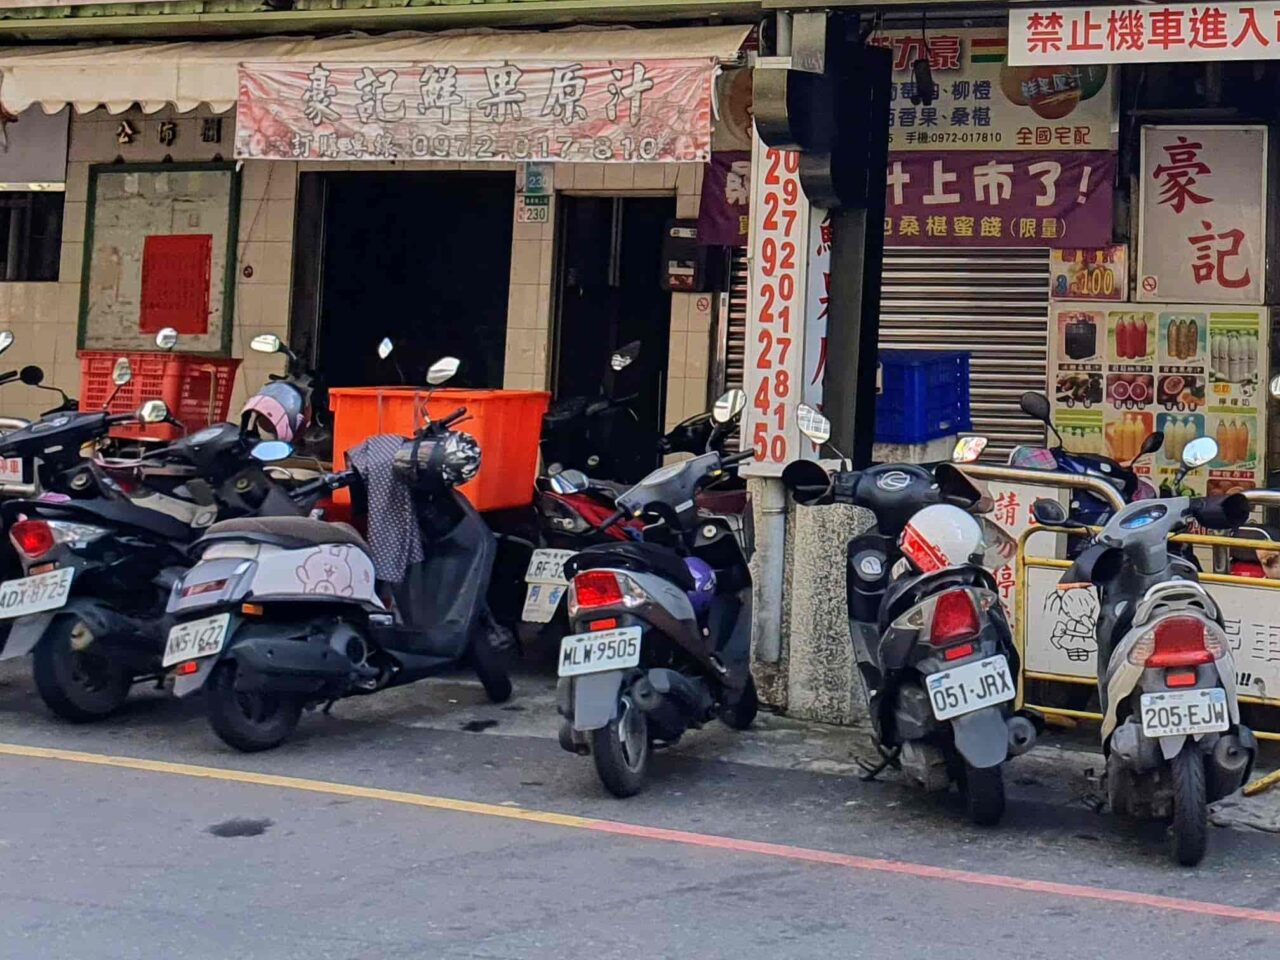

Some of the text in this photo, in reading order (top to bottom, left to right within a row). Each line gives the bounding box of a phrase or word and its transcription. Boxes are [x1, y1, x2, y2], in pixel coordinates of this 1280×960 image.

[302, 61, 655, 127] 豪記鮮果原汁
[1016, 126, 1092, 145] 全國宅配
[526, 208, 546, 221] 230
[1153, 136, 1251, 289] 豪記
